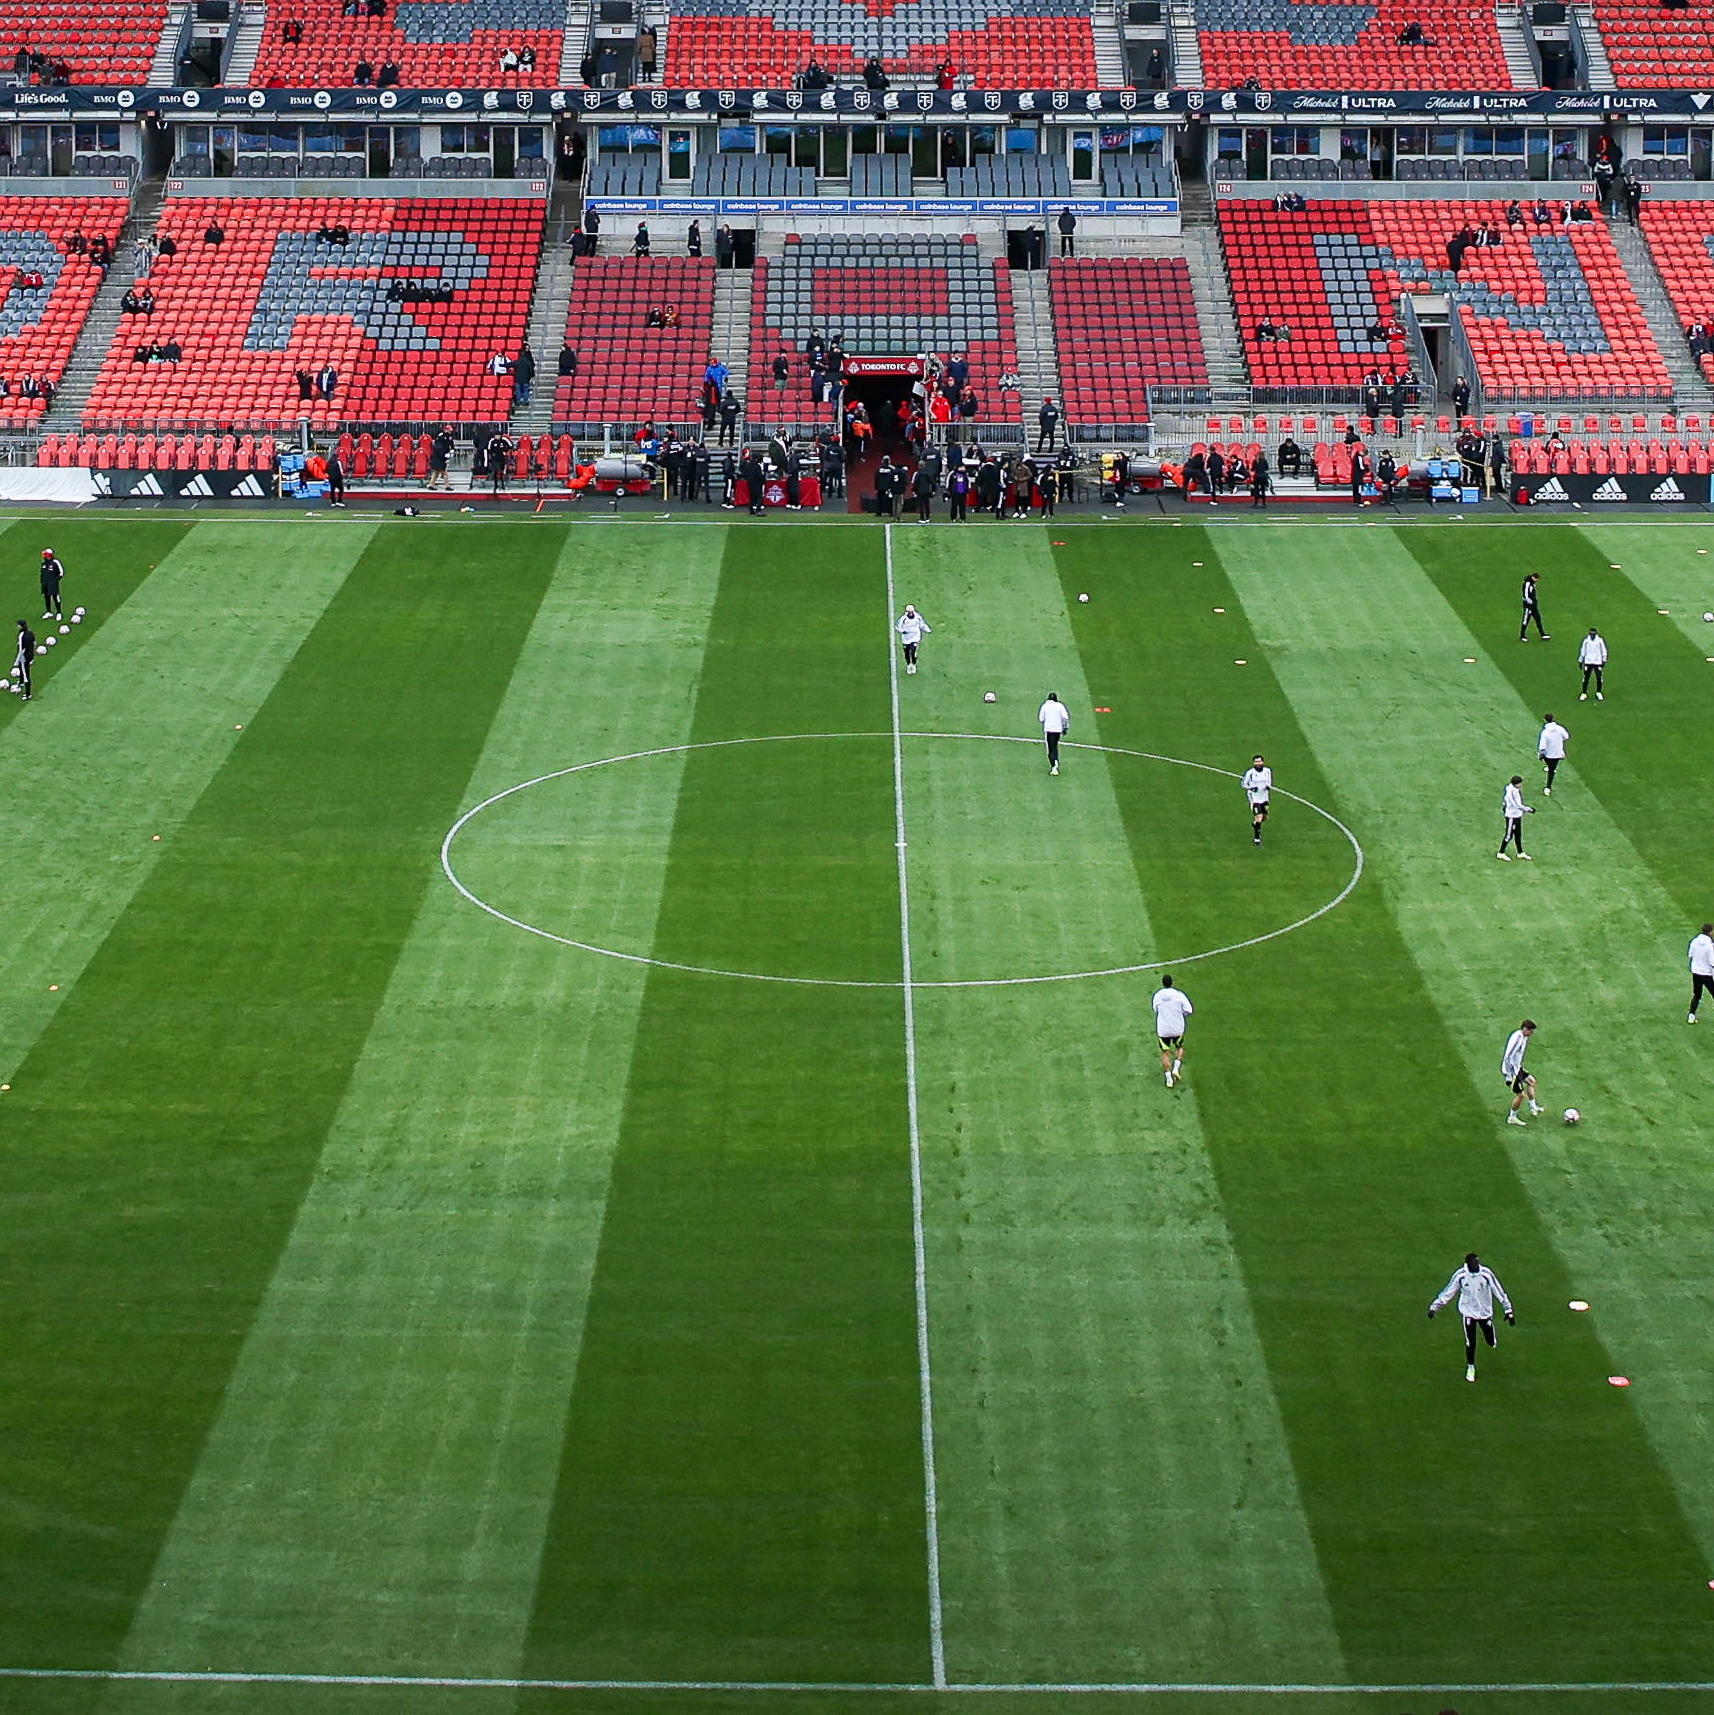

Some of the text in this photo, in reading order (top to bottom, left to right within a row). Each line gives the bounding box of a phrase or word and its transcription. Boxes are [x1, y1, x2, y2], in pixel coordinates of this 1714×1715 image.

[14, 92, 69, 104] Life's Good.
[94, 95, 116, 103] BMO
[158, 95, 180, 103] BMO
[224, 96, 246, 104] BMO
[290, 96, 312, 104] BMO
[356, 97, 378, 105] BMO
[421, 97, 443, 105] BMO
[1293, 96, 1396, 109] Michelob ULTRA
[1425, 96, 1527, 109] Michelob ULTRA
[1555, 96, 1657, 109] Michelob ULTRA
[1534, 492, 1569, 500] adidas
[1592, 492, 1627, 500] adidas
[1650, 492, 1685, 500] adidas
